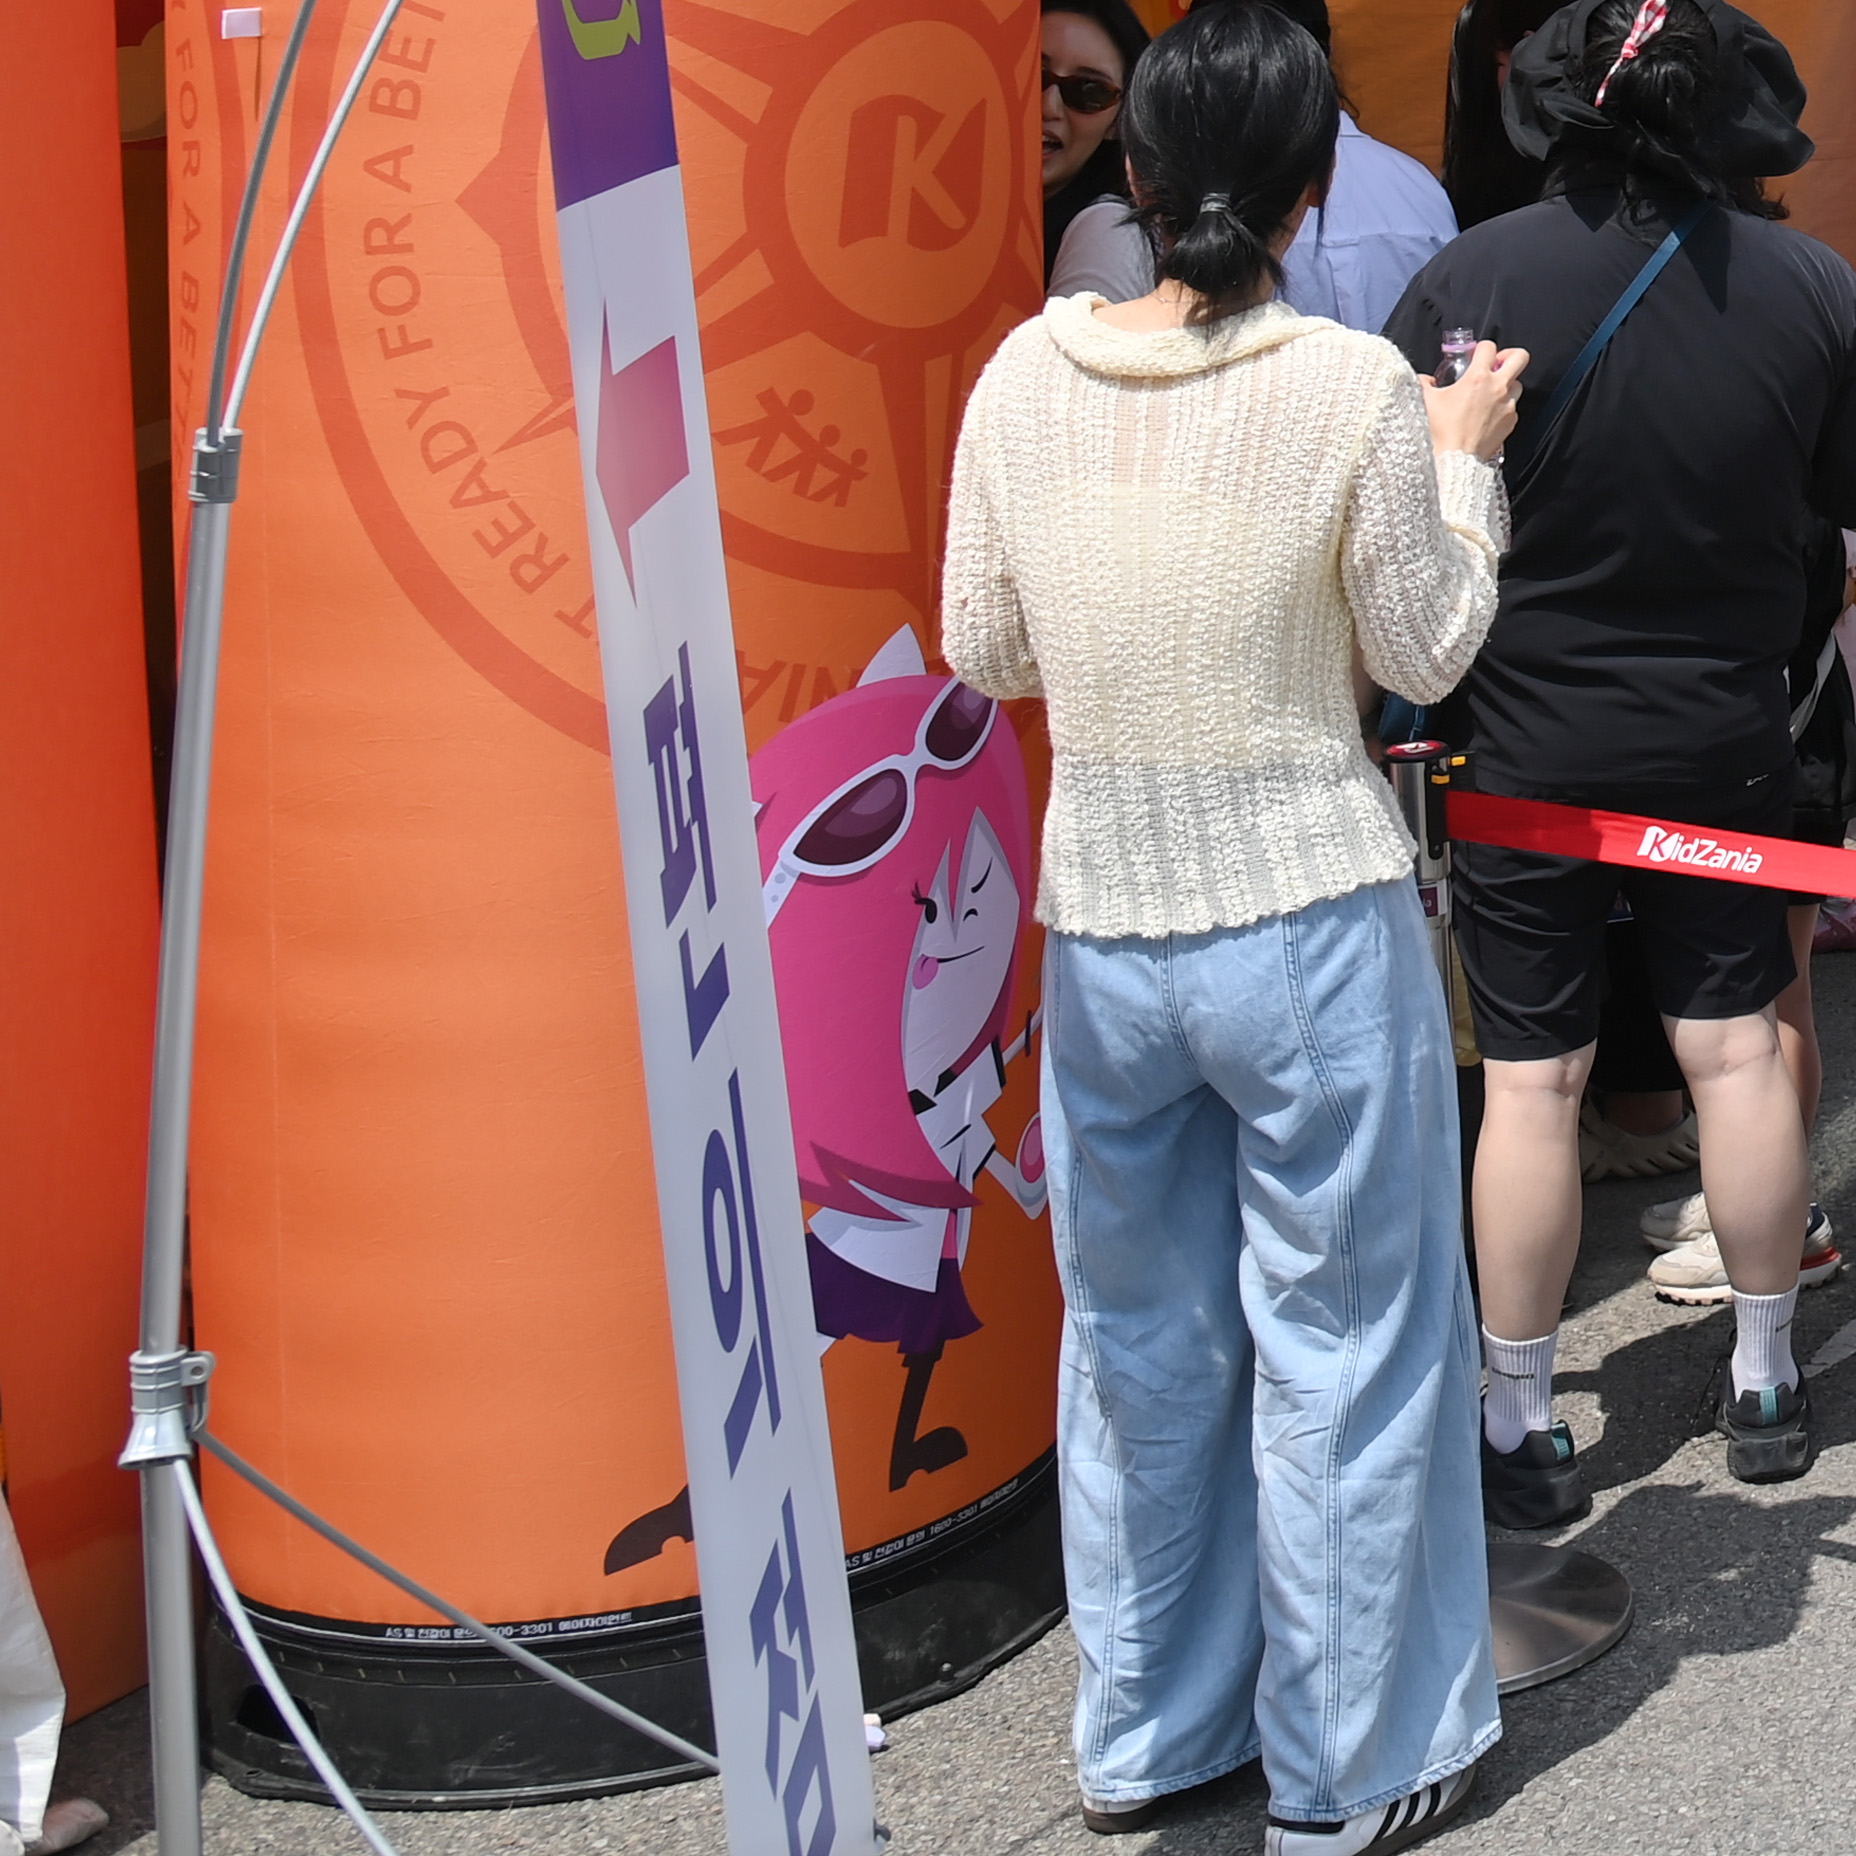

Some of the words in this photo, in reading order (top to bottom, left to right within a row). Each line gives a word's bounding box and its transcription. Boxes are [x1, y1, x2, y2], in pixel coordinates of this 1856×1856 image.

[363, 144, 415, 193] A
[363, 213, 433, 360] FOR
[395, 385, 571, 596] READY
[1637, 826, 1763, 874] KidZania
[489, 1621, 553, 1638] 600-3301
